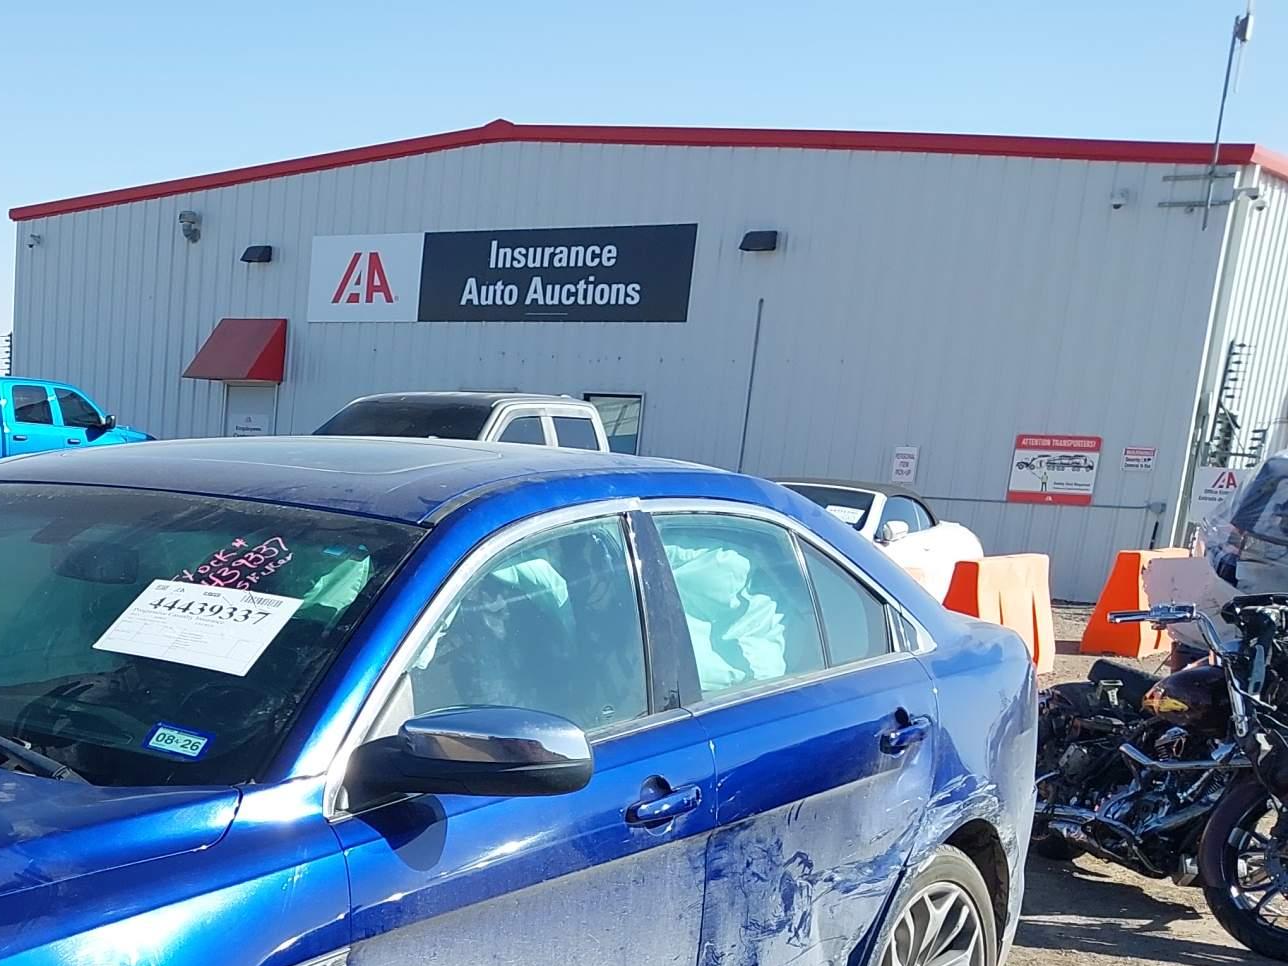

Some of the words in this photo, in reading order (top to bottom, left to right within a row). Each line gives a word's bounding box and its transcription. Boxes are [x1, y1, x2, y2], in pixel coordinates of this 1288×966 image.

[489, 240, 618, 269] Insurance
[460, 277, 518, 306] Auto
[524, 276, 641, 306] Auctions
[1022, 438, 1051, 447] ATTENTION
[149, 597, 272, 625] 44439337
[155, 732, 176, 745] 08
[180, 738, 202, 751] 26
